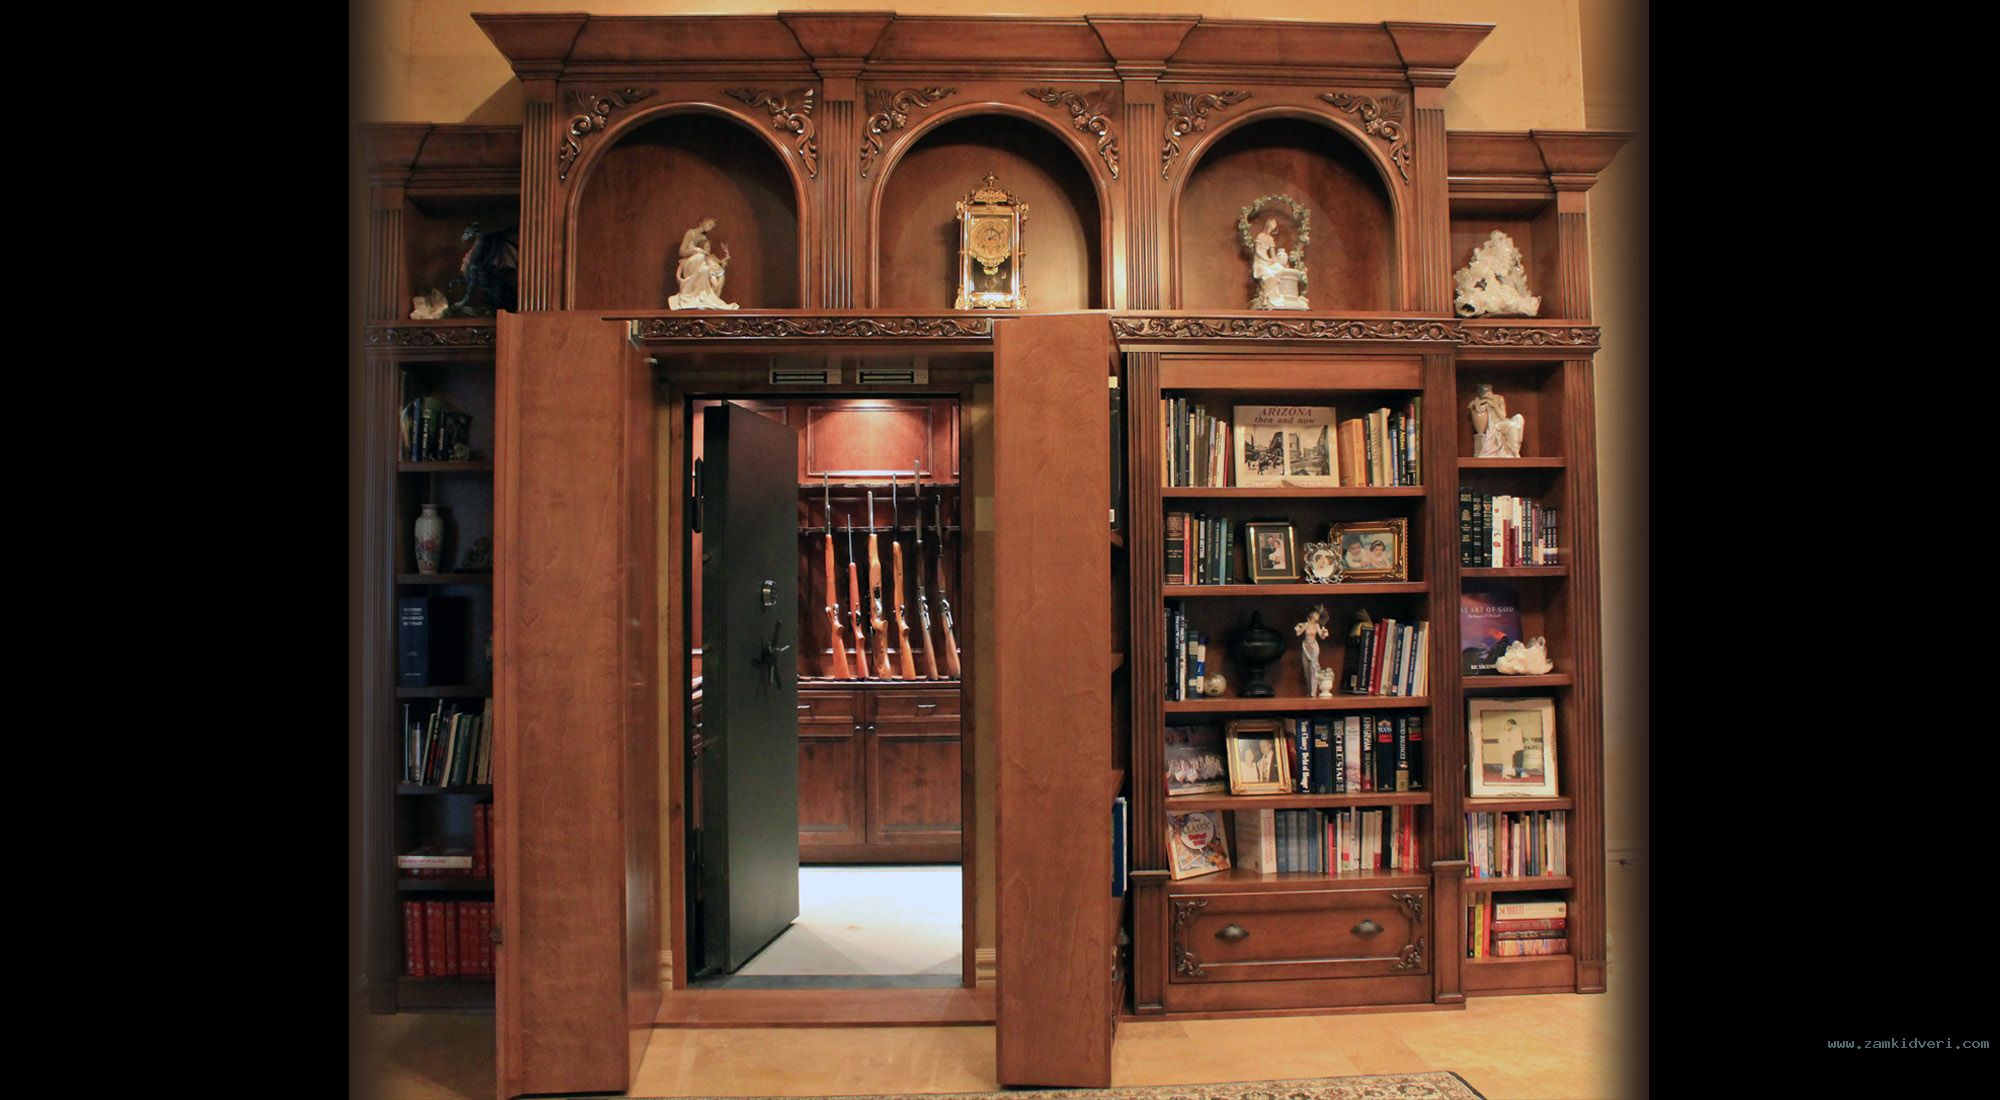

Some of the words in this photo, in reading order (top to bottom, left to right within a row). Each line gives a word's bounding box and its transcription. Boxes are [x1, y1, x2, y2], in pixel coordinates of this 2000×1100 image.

[1259, 407, 1313, 417] ARIZONA
[1254, 416, 1274, 424] then
[1335, 761, 1343, 783] STAR
